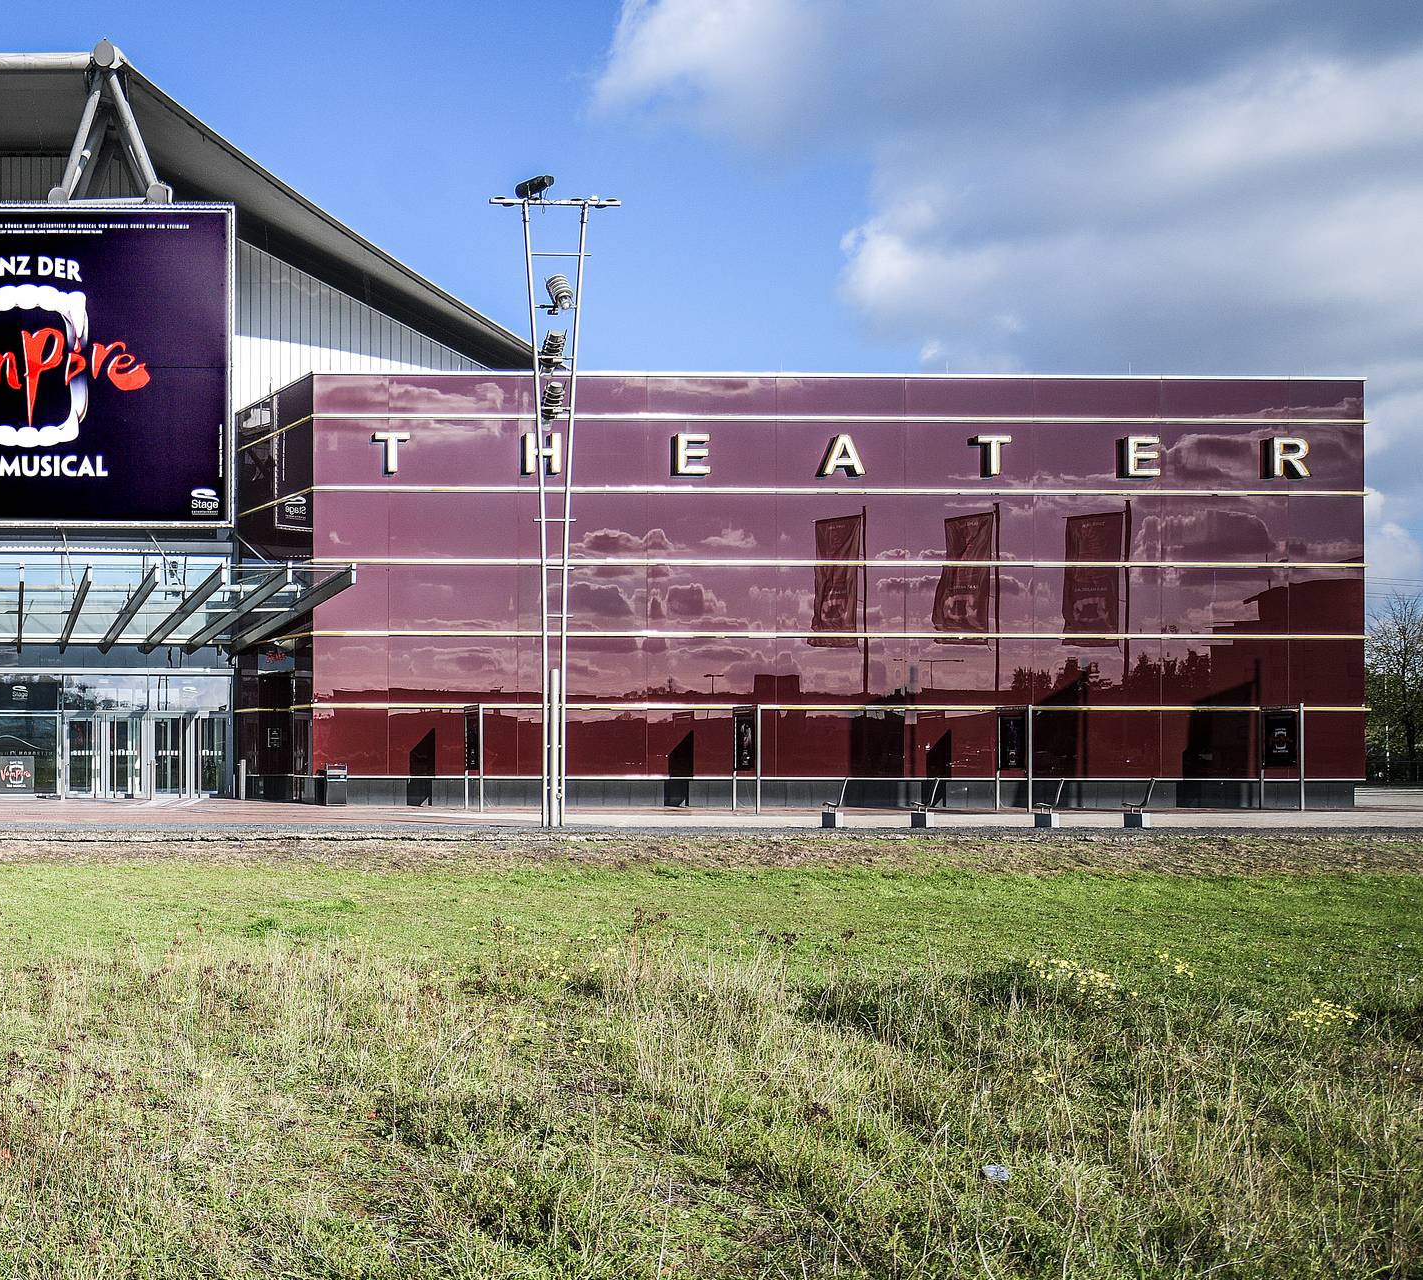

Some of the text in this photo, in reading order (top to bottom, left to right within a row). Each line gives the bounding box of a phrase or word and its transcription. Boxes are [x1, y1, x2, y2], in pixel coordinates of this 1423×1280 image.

[37, 256, 82, 282] DER
[372, 431, 1311, 478] THEATER
[191, 500, 219, 510] Stage
